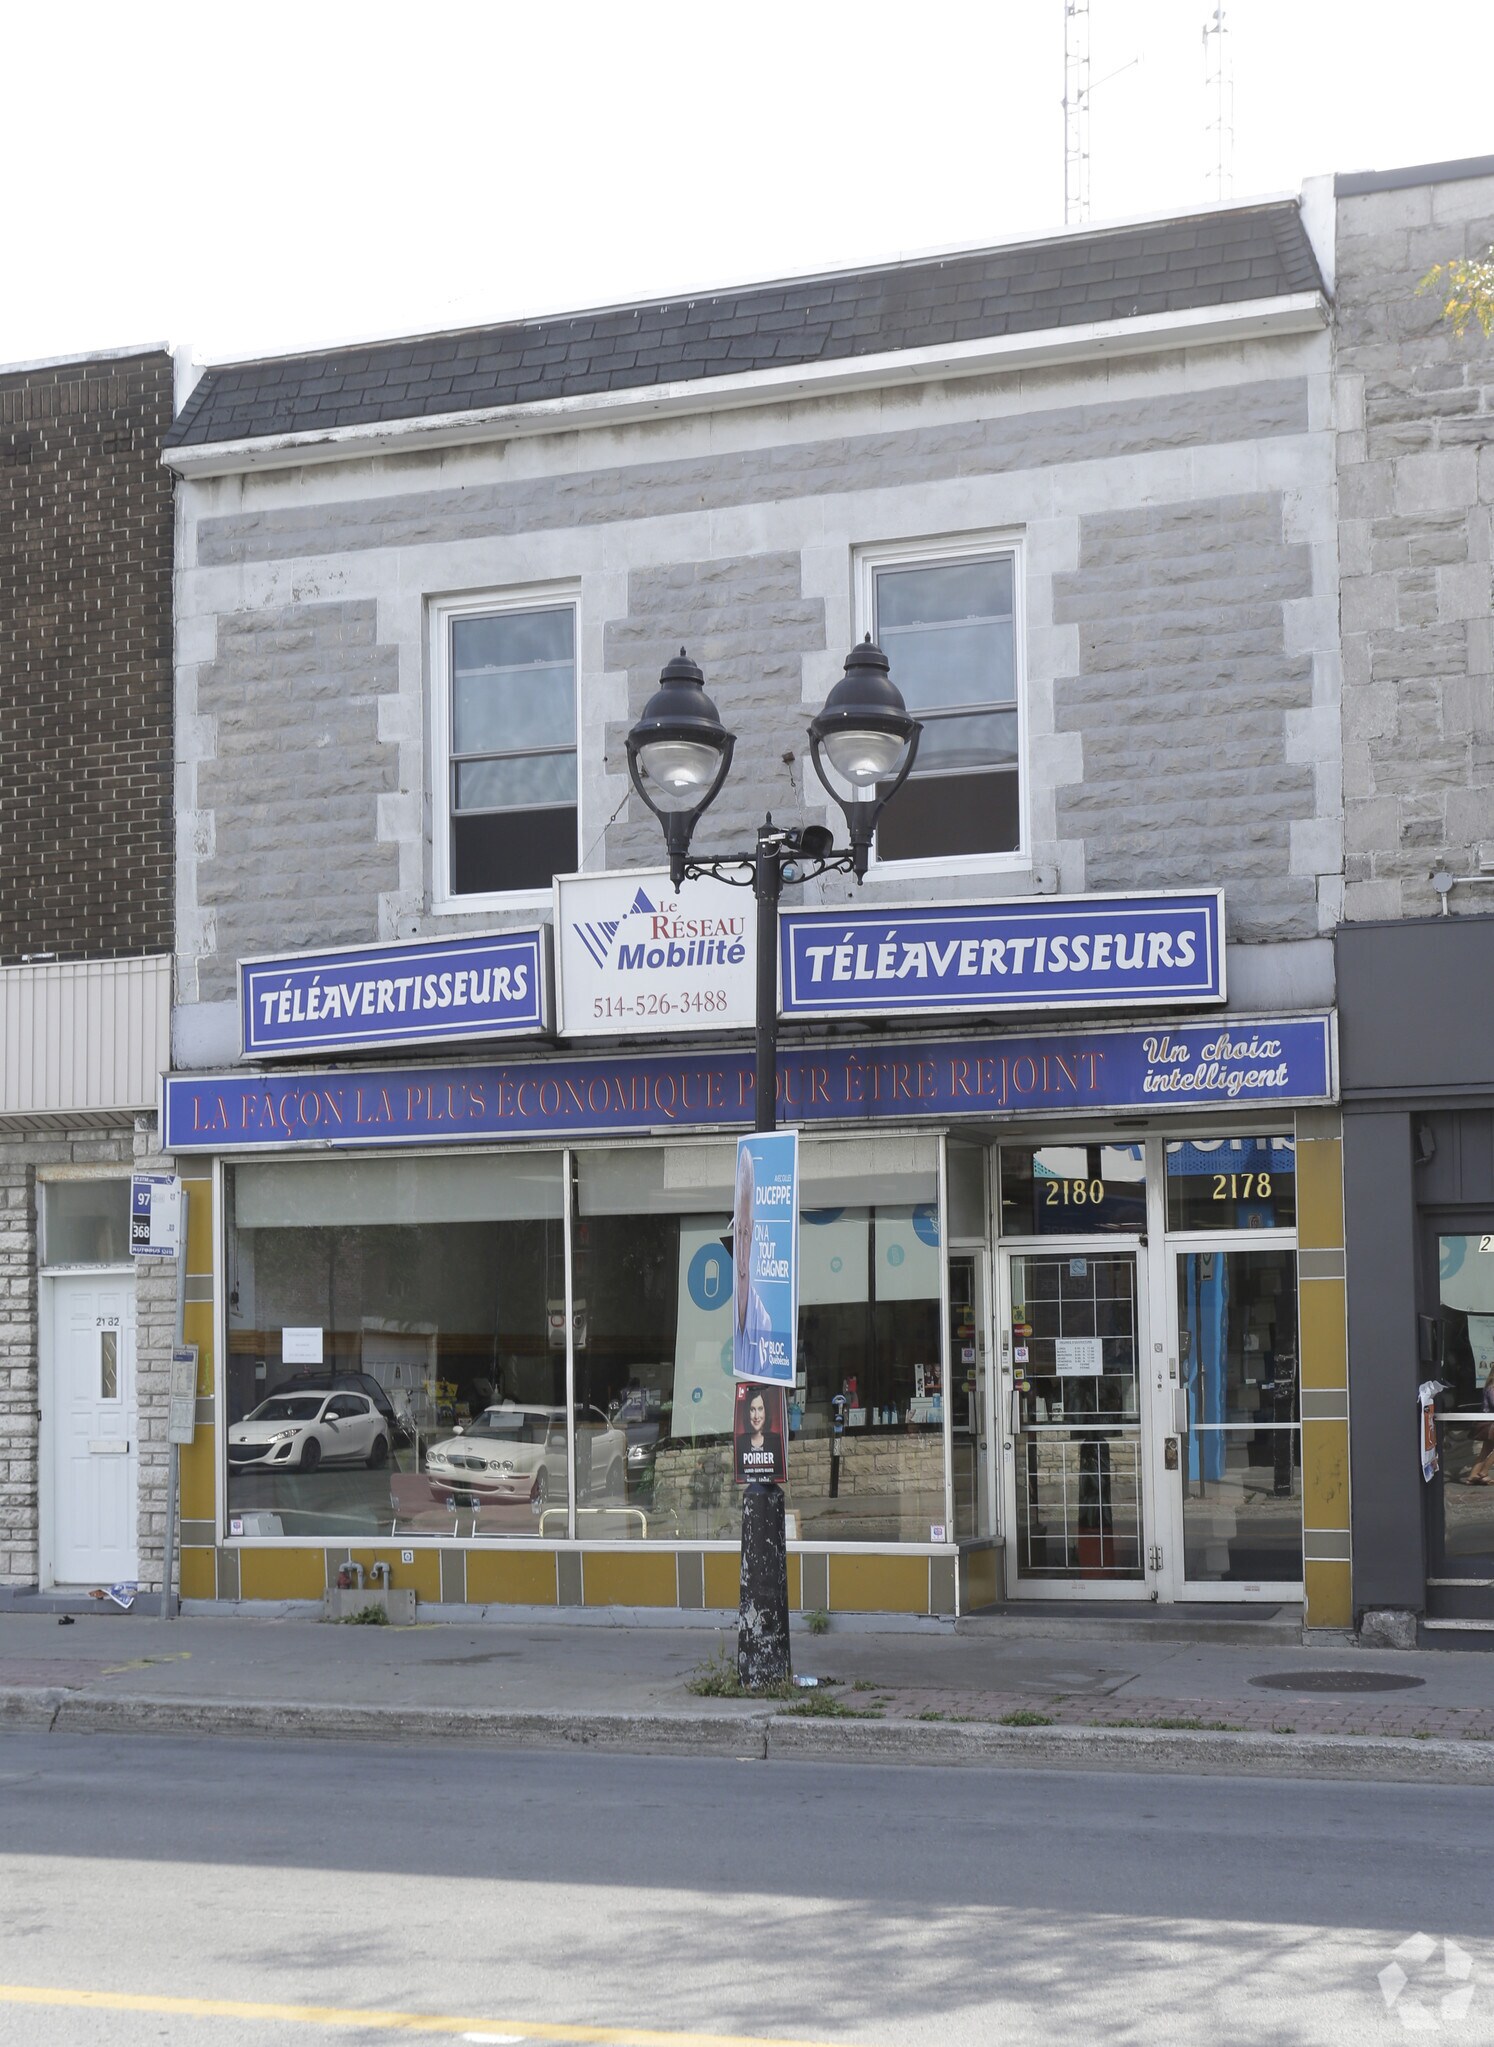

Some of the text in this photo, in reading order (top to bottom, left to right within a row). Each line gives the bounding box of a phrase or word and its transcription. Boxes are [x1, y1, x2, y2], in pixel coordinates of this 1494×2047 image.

[659, 901, 678, 913] Le
[650, 915, 746, 940] RÉSEAU
[617, 936, 746, 970] Mobilité
[805, 930, 1197, 982] TÉLÉAVERTISSEURS
[259, 964, 528, 1025] TÉLÉAVERTISSEURS
[593, 990, 728, 1018] 514-526-3488
[1142, 1033, 1282, 1064] Un choix
[1142, 1062, 1289, 1097] intelligent
[191, 1052, 1106, 1136] LA FAÇON LA PLUS ÉCONOMIQUE PUR ÊTRE REJOINT
[756, 1185, 791, 1205] DUCEPPE
[1045, 1179, 1105, 1205] 2180
[1212, 1172, 1273, 1200] 2178
[137, 1192, 151, 1206] 97
[133, 1225, 150, 1238] 368
[759, 1241, 776, 1260] TOUT
[760, 1259, 789, 1278] GAGNER
[768, 1341, 784, 1356] BLOC
[743, 1451, 774, 1465] POIRIER
